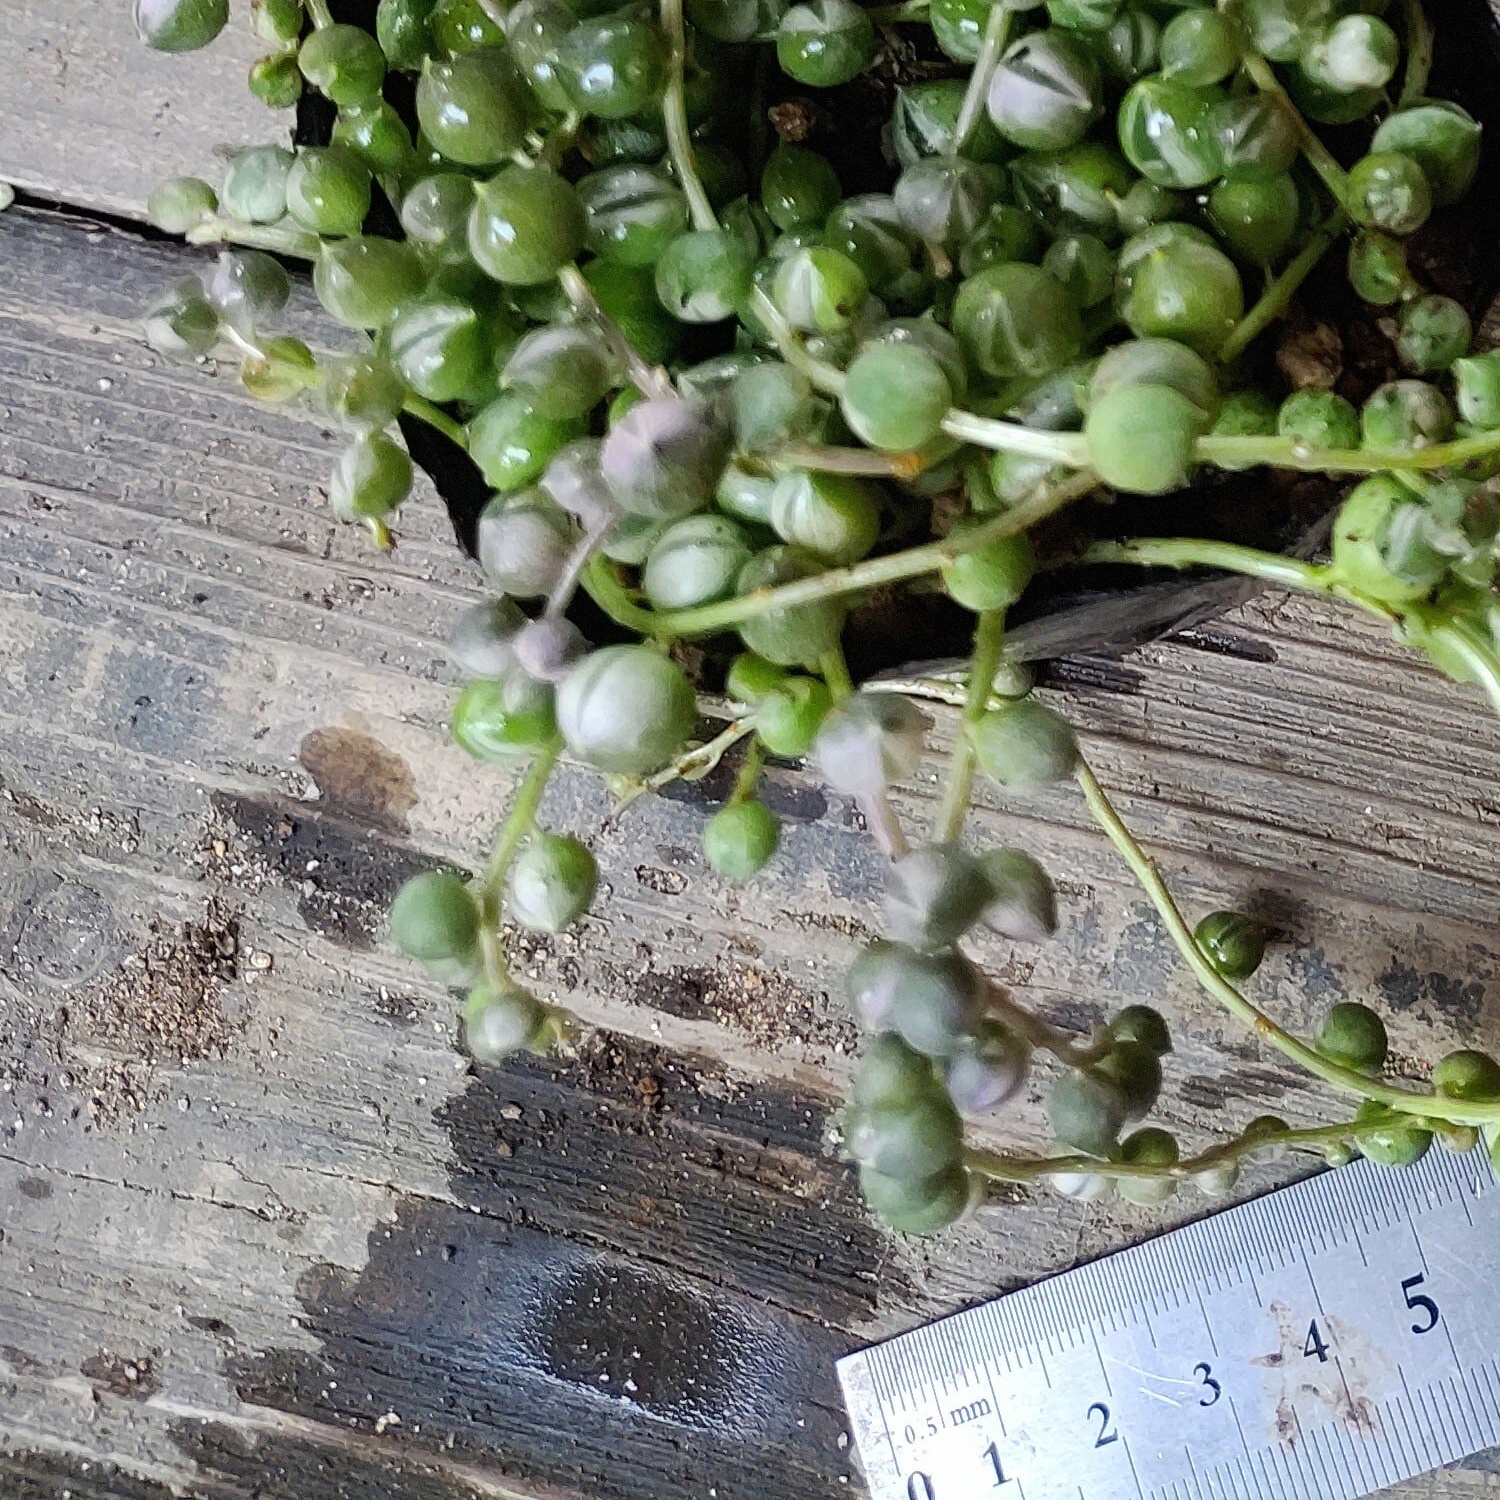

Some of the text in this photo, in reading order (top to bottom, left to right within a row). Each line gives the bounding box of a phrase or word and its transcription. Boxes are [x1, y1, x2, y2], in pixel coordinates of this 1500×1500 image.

[904, 1397, 993, 1445] 0.5 mm
[983, 1440, 1013, 1488] 1
[1086, 1402, 1119, 1449] 2
[1193, 1362, 1222, 1407] 3
[1303, 1318, 1330, 1362] 4
[1401, 1271, 1440, 1334] 5
